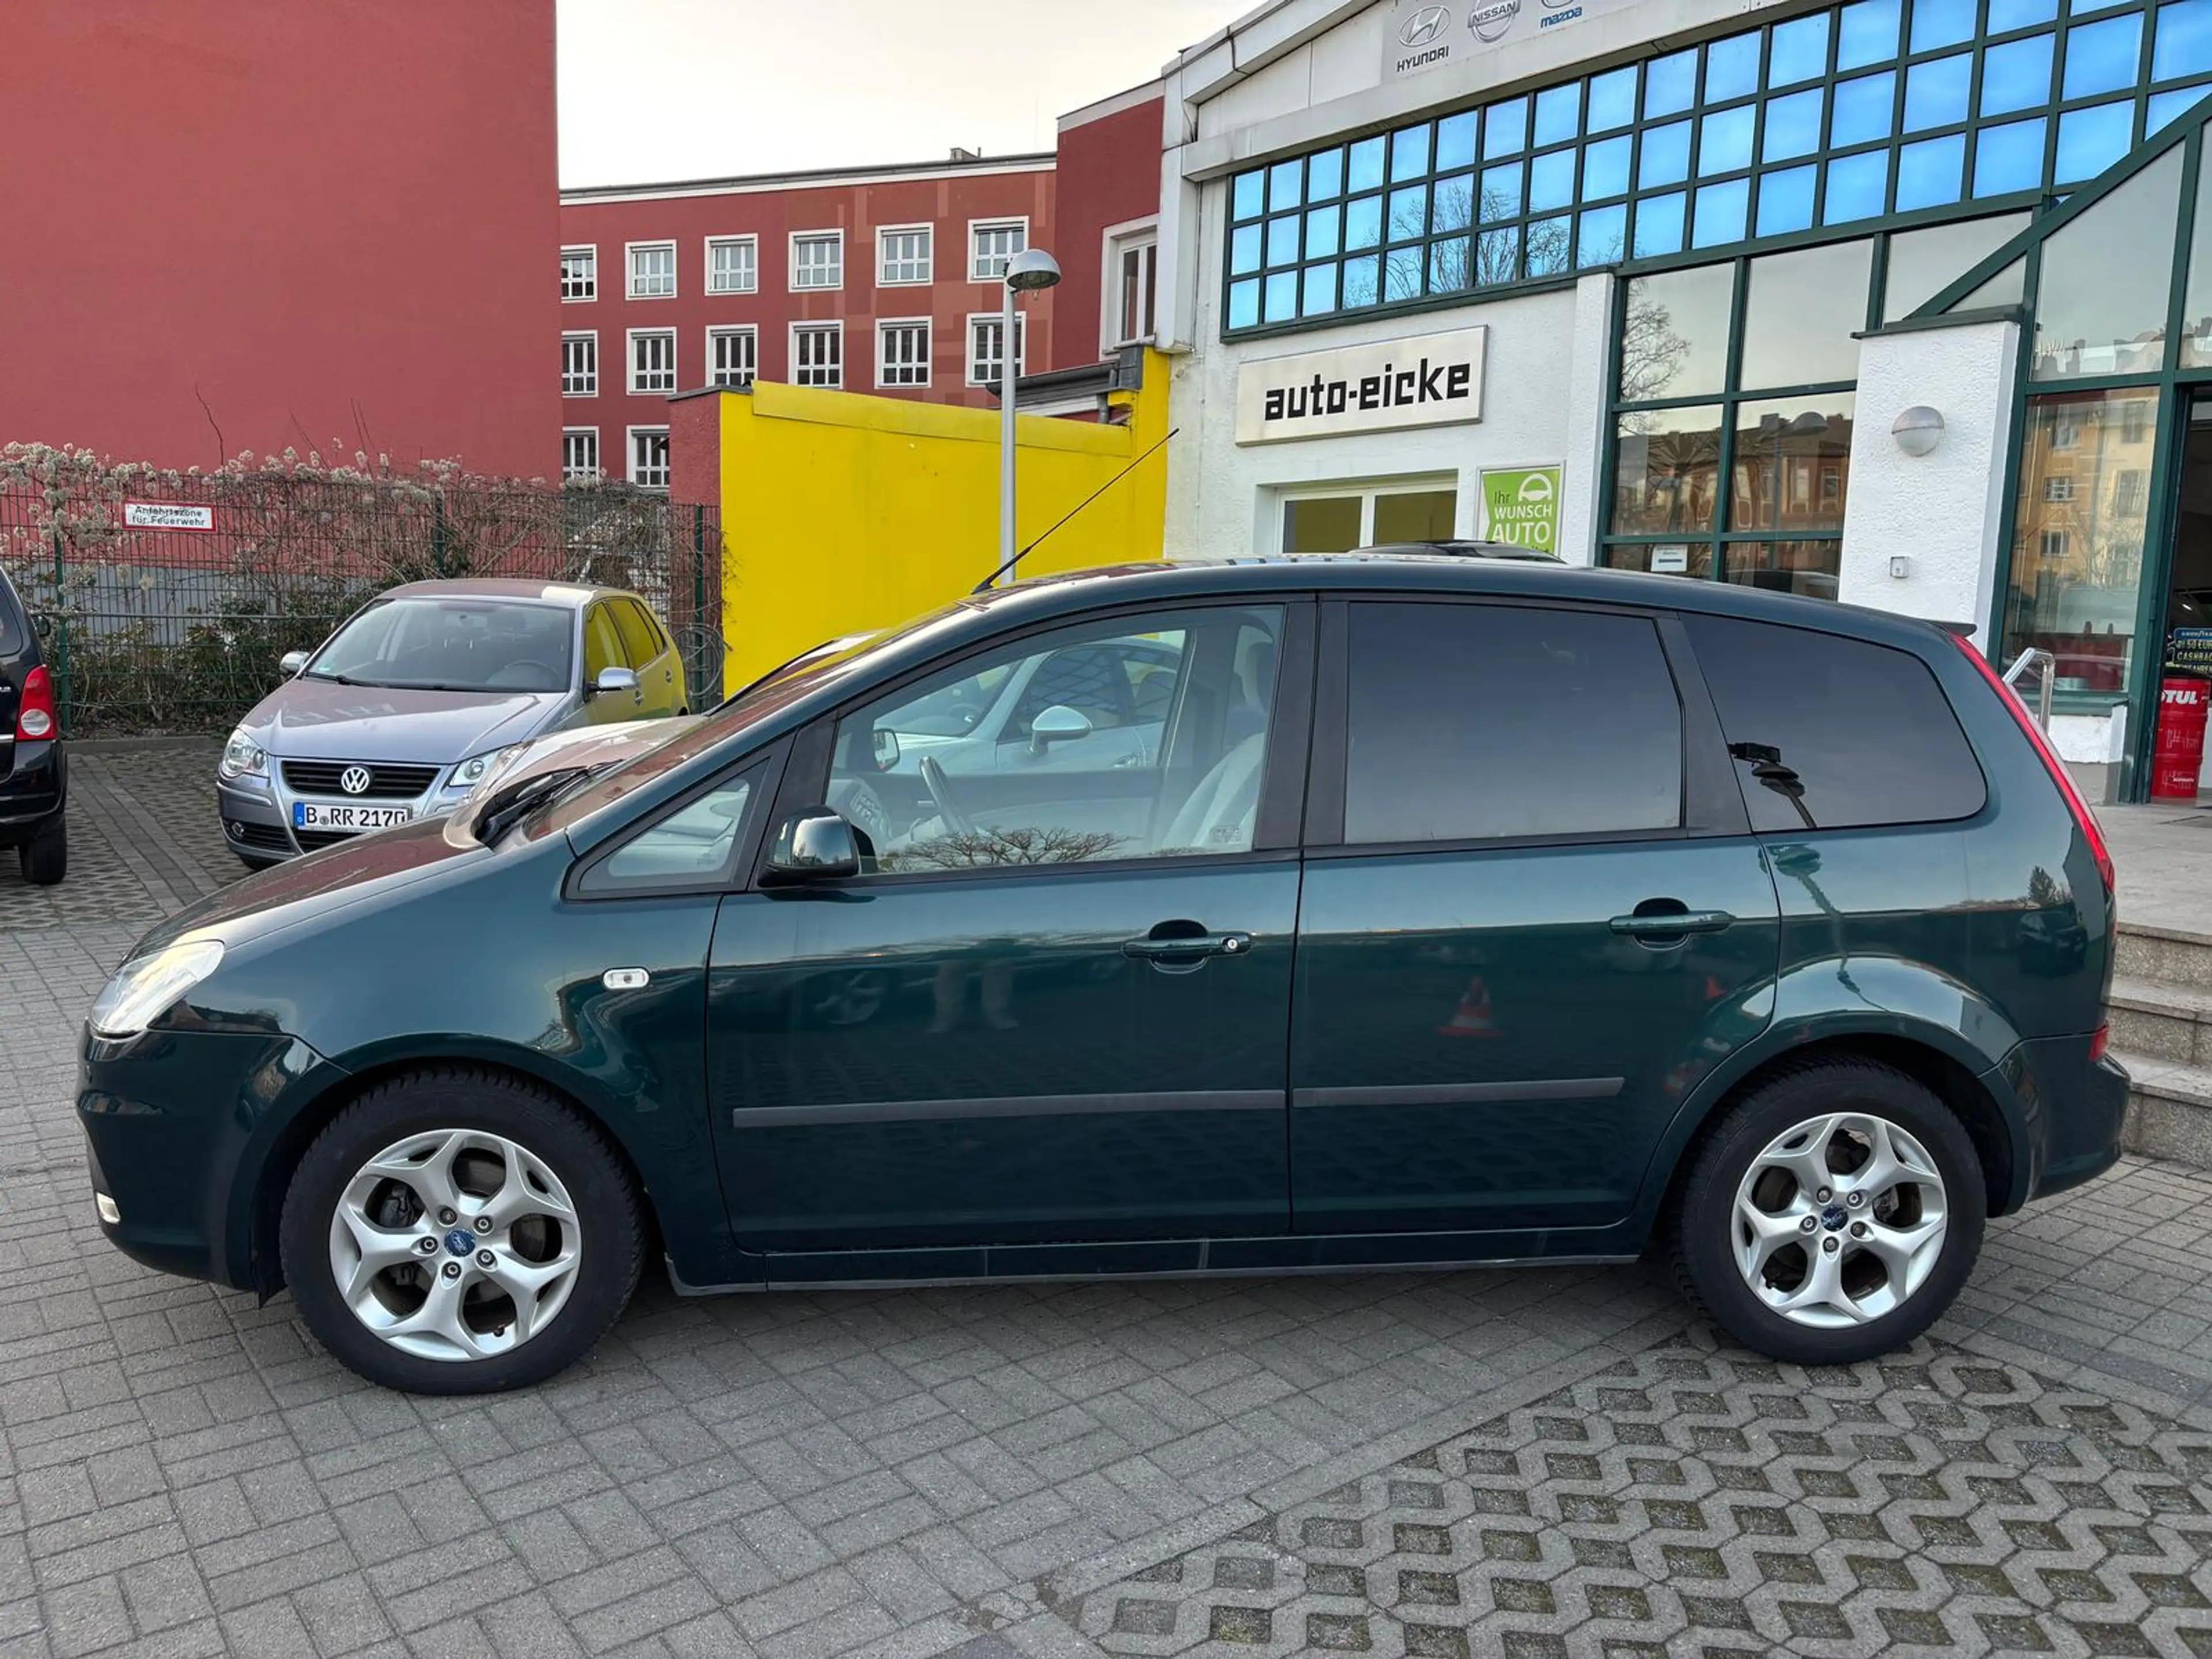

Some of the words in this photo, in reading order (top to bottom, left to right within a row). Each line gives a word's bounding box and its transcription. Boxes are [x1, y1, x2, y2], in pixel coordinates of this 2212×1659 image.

[1472, 1, 1516, 23] NISSAN
[1397, 46, 1449, 72] HYUNDAI
[1265, 358, 1471, 421] auto-eicke
[1494, 491, 1510, 504] Ihr
[150, 516, 206, 526] Feuerwehr
[1494, 504, 1552, 520] WUNSCH
[1492, 521, 1551, 544] AUTO
[306, 807, 317, 824] B
[330, 809, 354, 826] RR
